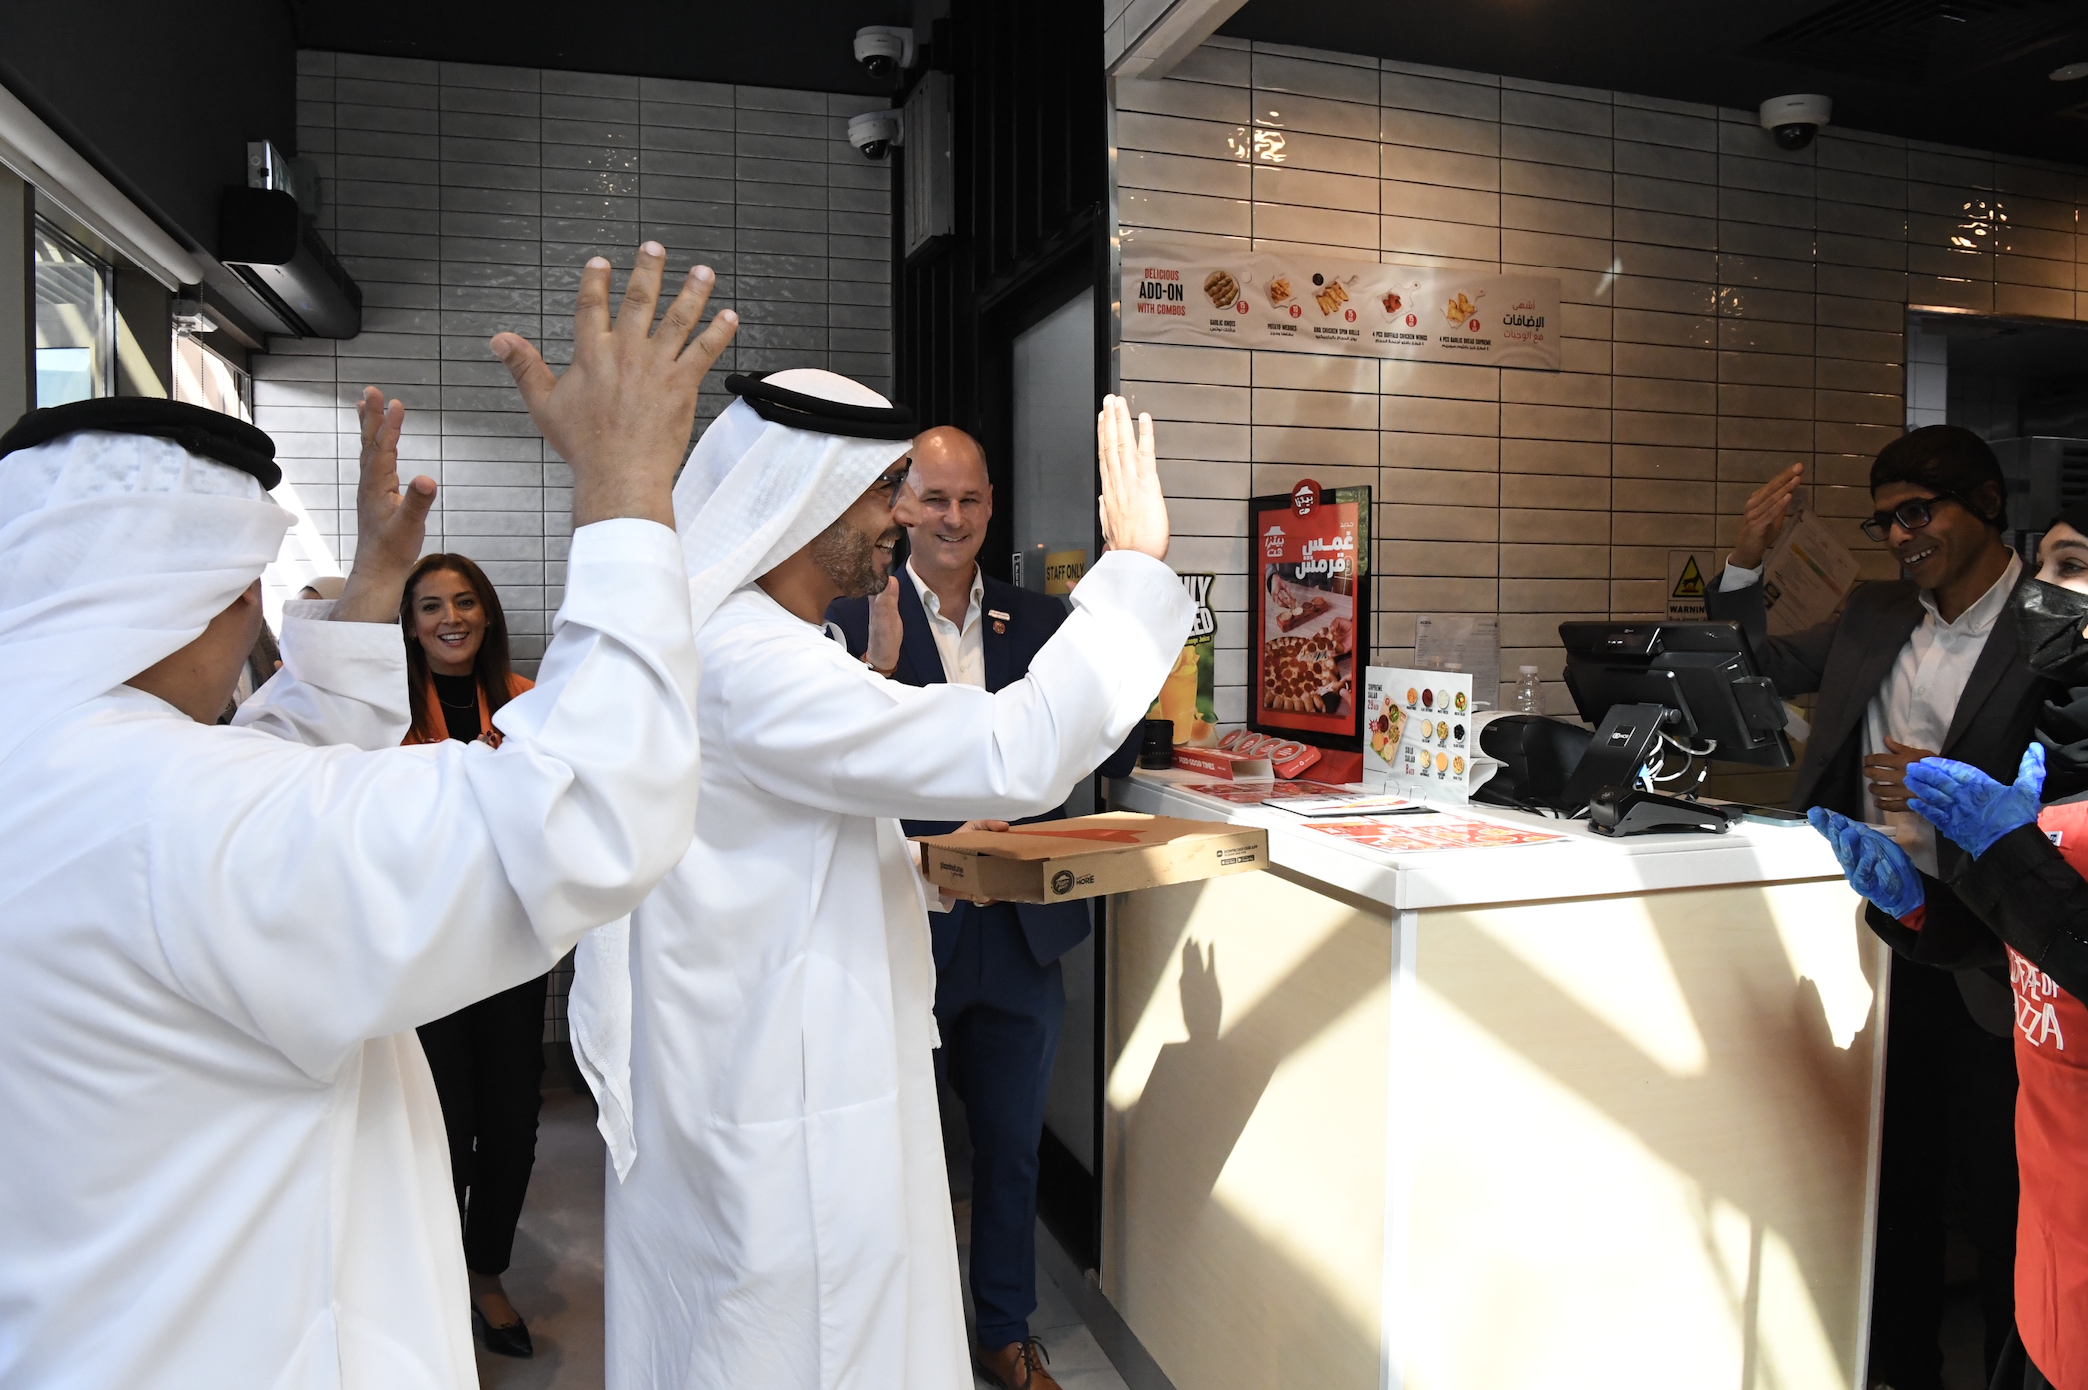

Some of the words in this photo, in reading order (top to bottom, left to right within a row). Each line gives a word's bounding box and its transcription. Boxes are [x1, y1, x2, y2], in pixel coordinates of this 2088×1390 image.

[1144, 268, 1179, 281] DELICIOUS
[1139, 281, 1183, 301] ADD-ON
[1137, 302, 1155, 314] WITH
[1157, 304, 1186, 316] COMBOS
[1512, 300, 1535, 310] أشهى
[1503, 314, 1545, 331] الإضافات
[1503, 330, 1532, 341] الوجبات
[1533, 334, 1544, 343] مع
[1340, 521, 1354, 529] جديد
[1302, 530, 1354, 556] غمس
[1046, 565, 1066, 580] STAFF
[1066, 562, 1085, 579] ONLY
[1669, 605, 1705, 614] WARNIN
[1367, 700, 1374, 710] 29
